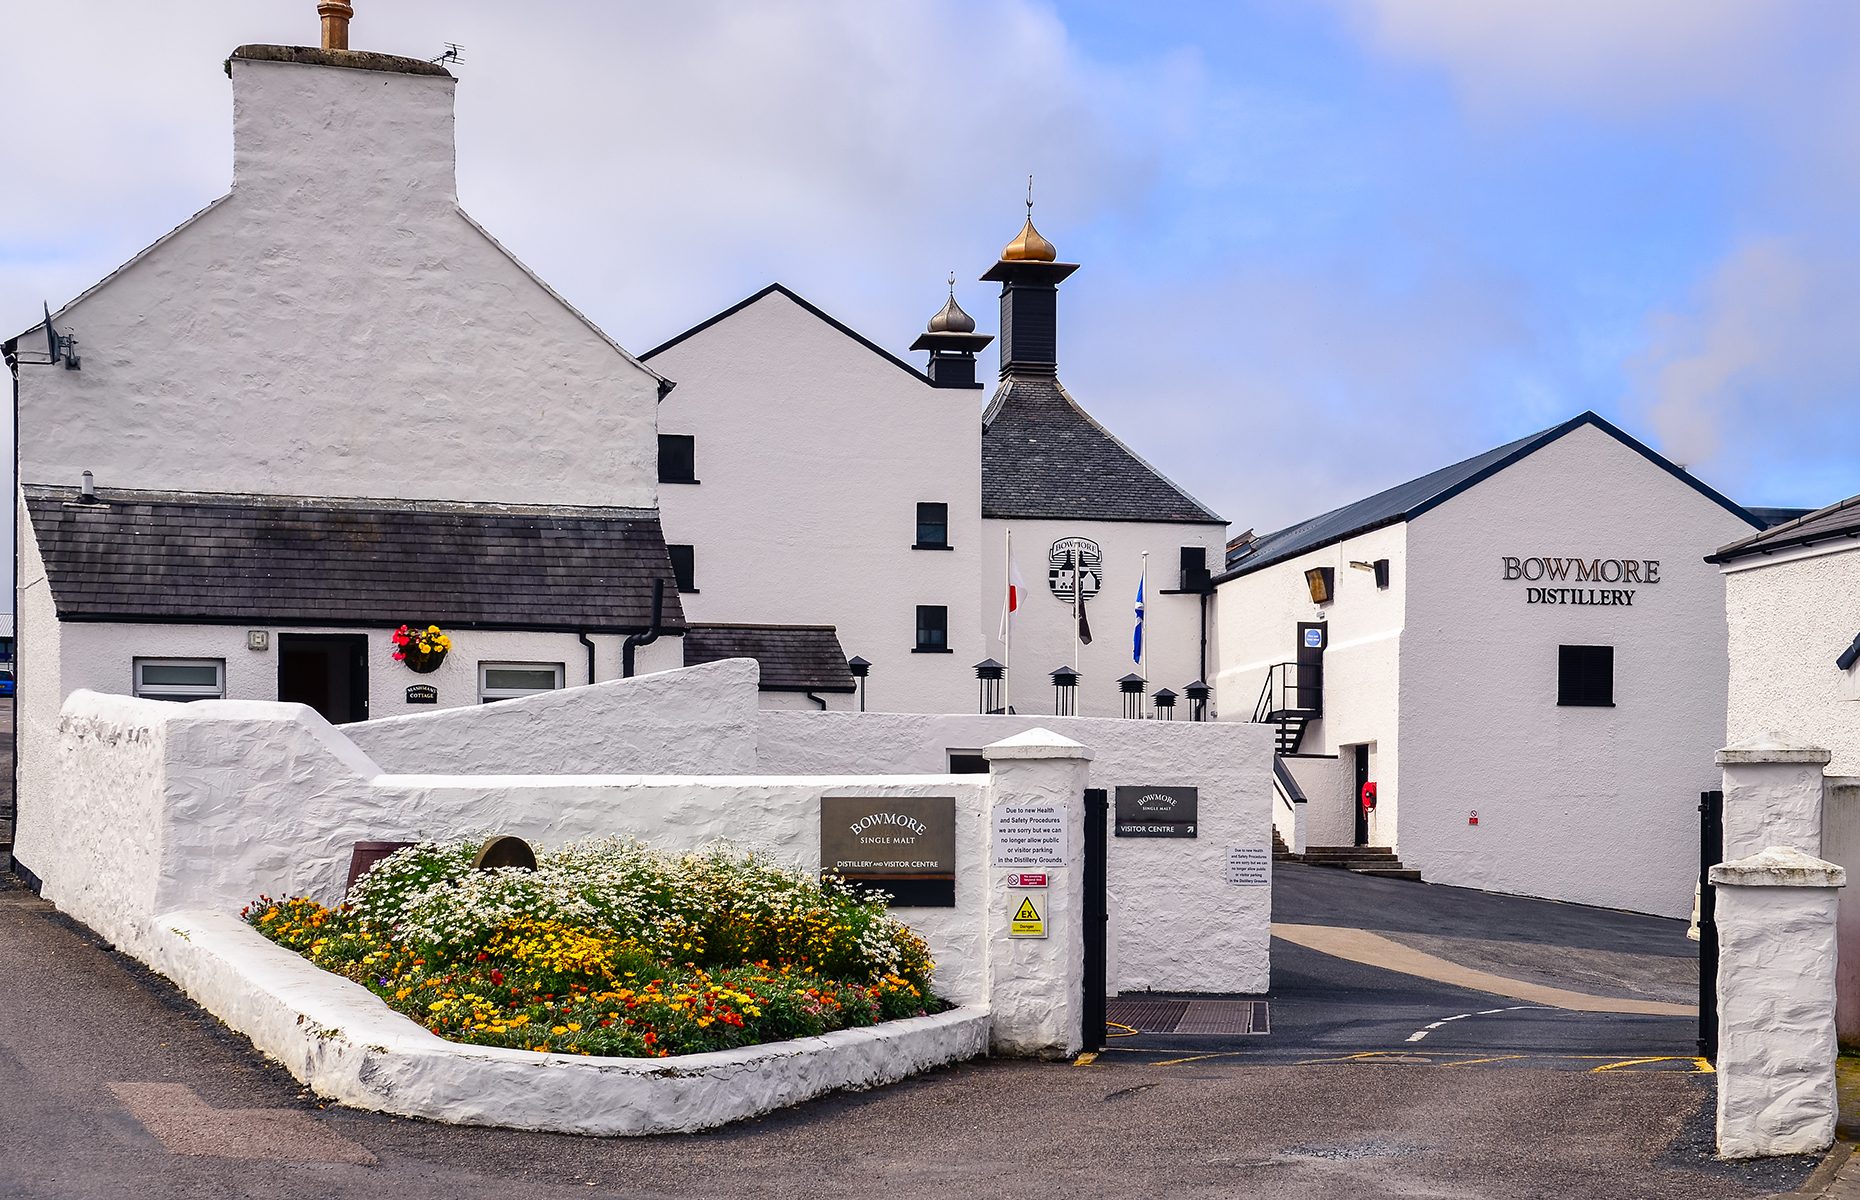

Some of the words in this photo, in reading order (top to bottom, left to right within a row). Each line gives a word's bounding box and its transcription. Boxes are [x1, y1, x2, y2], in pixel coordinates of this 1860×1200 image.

[1502, 556, 1661, 584] BOWMORE
[1526, 588, 1636, 606] DISTILLERY
[1137, 793, 1178, 807] BOWMORE
[849, 812, 927, 836] BOWMORE
[837, 860, 873, 868] DISTILLERY
[884, 860, 910, 868] VISITOR
[911, 860, 939, 868] CENTRE
